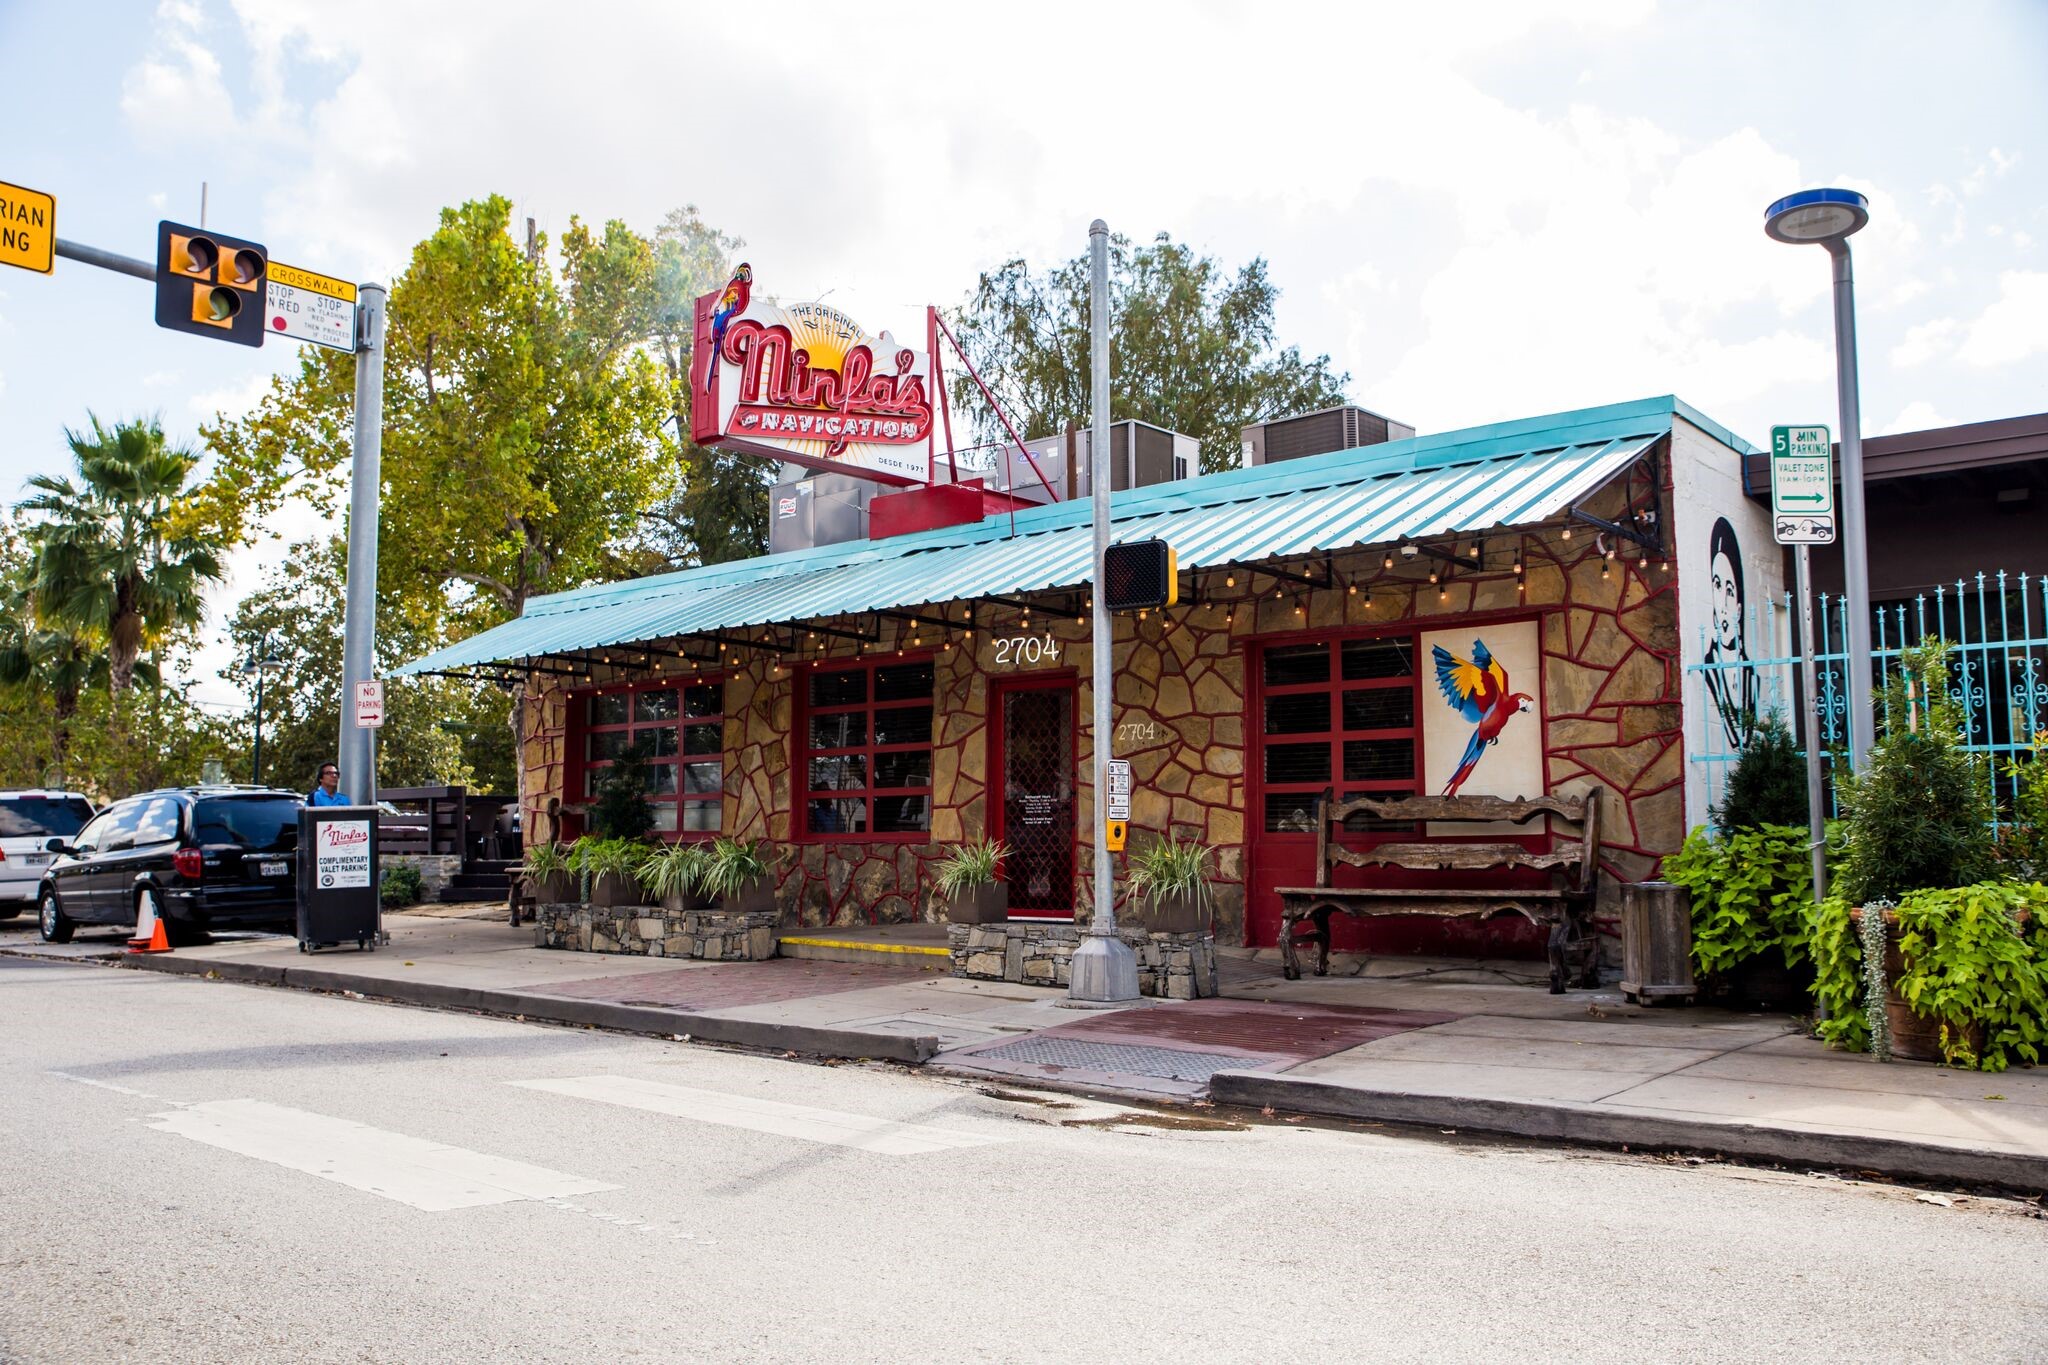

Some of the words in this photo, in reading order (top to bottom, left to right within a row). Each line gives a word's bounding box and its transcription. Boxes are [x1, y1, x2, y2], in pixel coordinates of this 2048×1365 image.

[271, 267, 345, 297] CROSSWALK
[268, 283, 295, 299] STOP
[278, 298, 300, 314] RED
[317, 296, 342, 312] STOP
[312, 314, 325, 323] RED
[792, 305, 813, 318] THE
[815, 306, 862, 338] ORIGINAL
[304, 322, 320, 331] THEN
[322, 327, 350, 339] PROCEED
[721, 319, 934, 457] Ninfa's
[760, 411, 918, 439] NAVIGATION
[1775, 434, 1787, 452] 5
[1798, 431, 1817, 442] MIN
[1791, 443, 1827, 455] PARKING
[878, 457, 903, 469] DESDE
[1778, 463, 1802, 473] VALET
[1804, 463, 1825, 473] ZONE
[995, 637, 1060, 665] 2704
[363, 687, 376, 697] NO
[358, 700, 382, 709] PARKING
[1118, 722, 1155, 741] 2704
[319, 856, 369, 865] COMPLIMENTARY
[321, 865, 340, 873] VALET
[341, 864, 368, 873] PARKING
